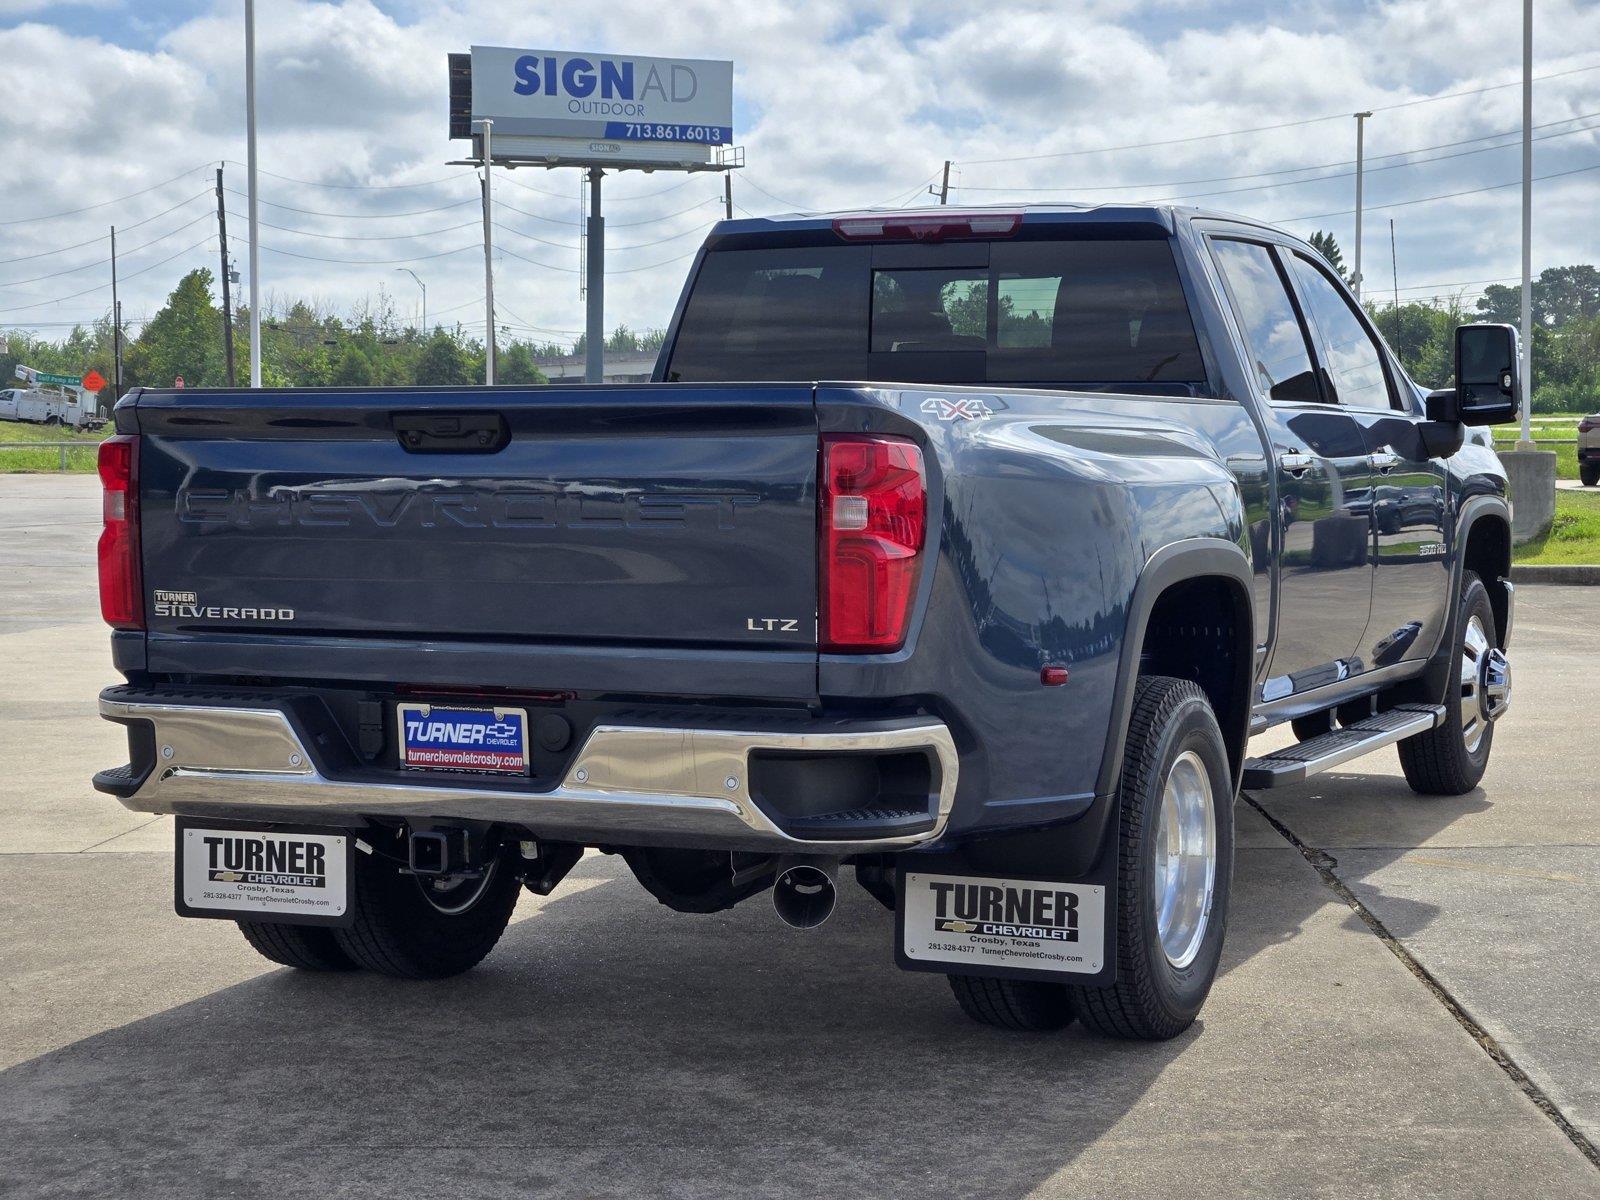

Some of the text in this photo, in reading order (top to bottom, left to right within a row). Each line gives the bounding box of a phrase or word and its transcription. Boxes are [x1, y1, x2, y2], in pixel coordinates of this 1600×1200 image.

[567, 100, 646, 117] OUTDOOR
[625, 123, 721, 142] 713.861.6013
[176, 488, 761, 530] CHEVROLET
[155, 592, 195, 603] TURNER
[154, 604, 295, 620] SILVERADO
[747, 618, 799, 631] LTZ
[406, 721, 486, 744] TURNER
[486, 738, 518, 746] CHEVROLET
[408, 749, 523, 768] turnerchevroletcrosby.com
[204, 837, 325, 875] TURNER
[247, 873, 319, 887] CHEVROLET
[237, 884, 295, 894] Crosby, Texas
[203, 891, 330, 907] 281-328-4377 TurnerChevroletCrosby.com
[929, 882, 1079, 928] TURNER
[983, 924, 1069, 940] CHEVROLET
[969, 935, 1041, 948] Crosby, Texas
[928, 942, 1083, 963] 281-328-4377 TurnerChevroletCrosby.com
